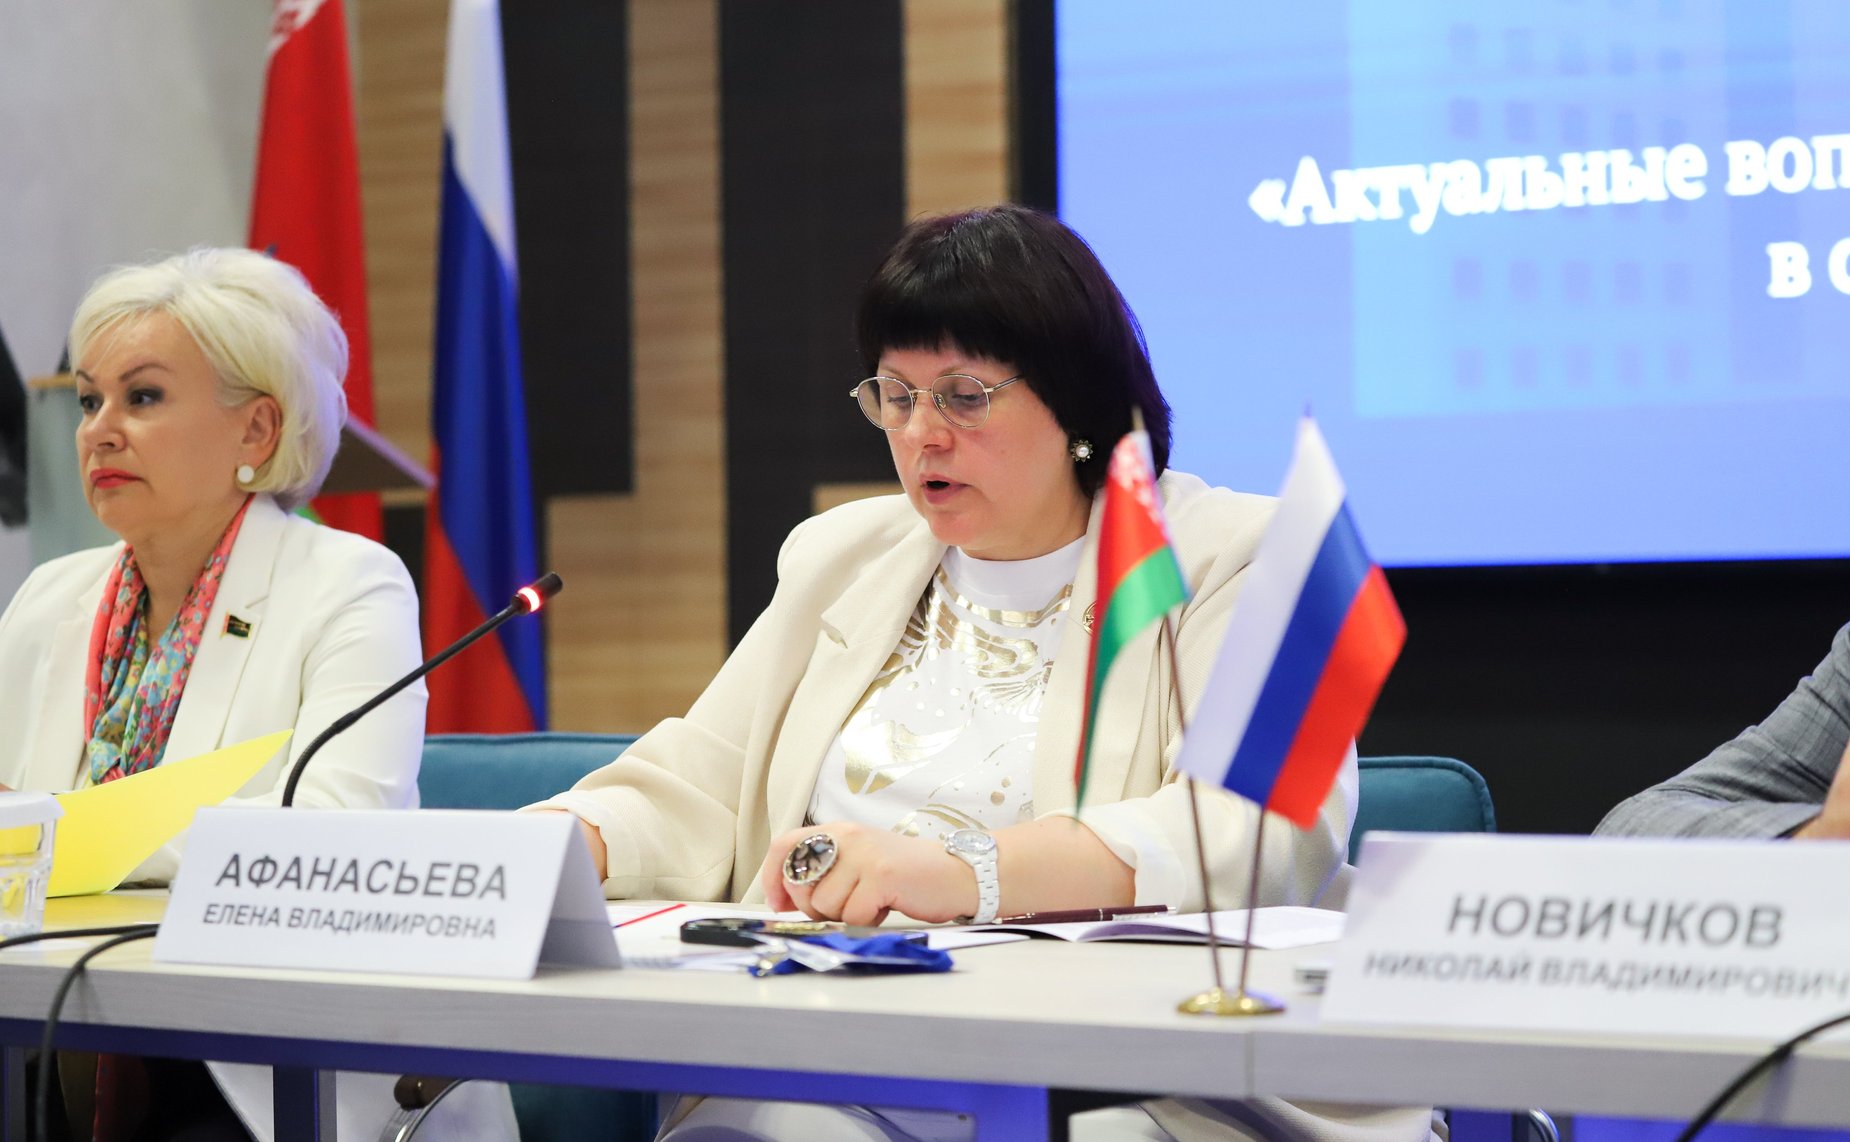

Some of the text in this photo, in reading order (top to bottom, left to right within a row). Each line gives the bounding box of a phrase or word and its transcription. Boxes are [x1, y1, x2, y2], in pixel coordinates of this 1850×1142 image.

[1249, 143, 1707, 234] «Актуальные
[215, 853, 507, 900] АФАНАСЬЕВА
[203, 903, 497, 939] ЕЛЕНА ВЛАДИМИРОВНА
[1447, 893, 1785, 948] НОВИЧКОВ
[1363, 952, 1850, 999] НИКОЛАЙ ВЛАДИМИРОВИЧ
